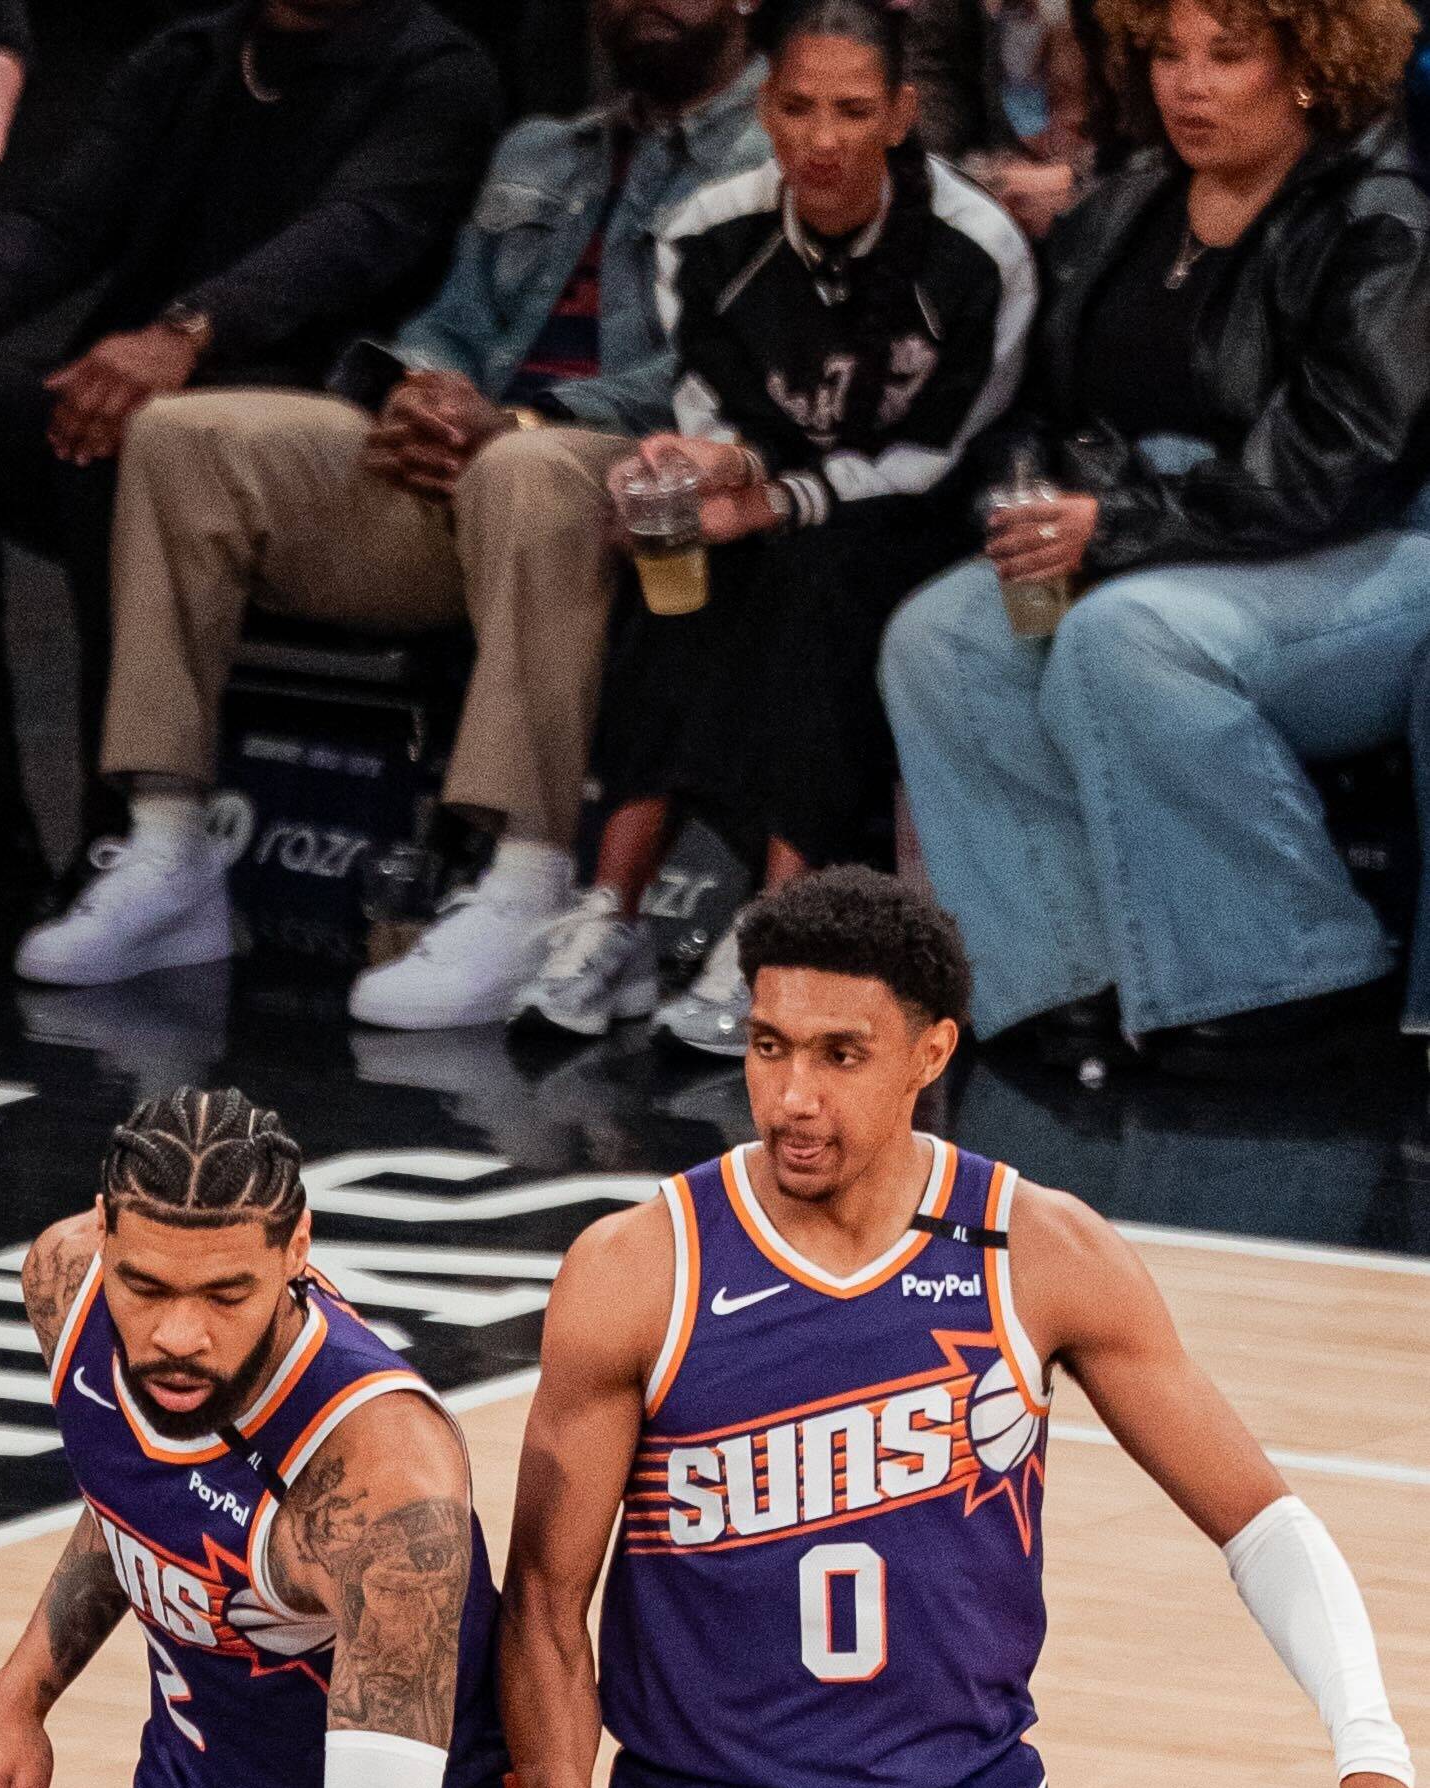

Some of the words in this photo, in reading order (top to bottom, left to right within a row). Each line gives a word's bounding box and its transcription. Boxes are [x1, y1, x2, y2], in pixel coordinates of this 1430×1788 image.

[953, 1225, 968, 1242] AL
[901, 1274, 981, 1303] PayPal
[247, 1451, 263, 1471] AL
[667, 1386, 953, 1546] SUNS
[188, 1470, 250, 1528] PayPal
[799, 1541, 888, 1683] 0
